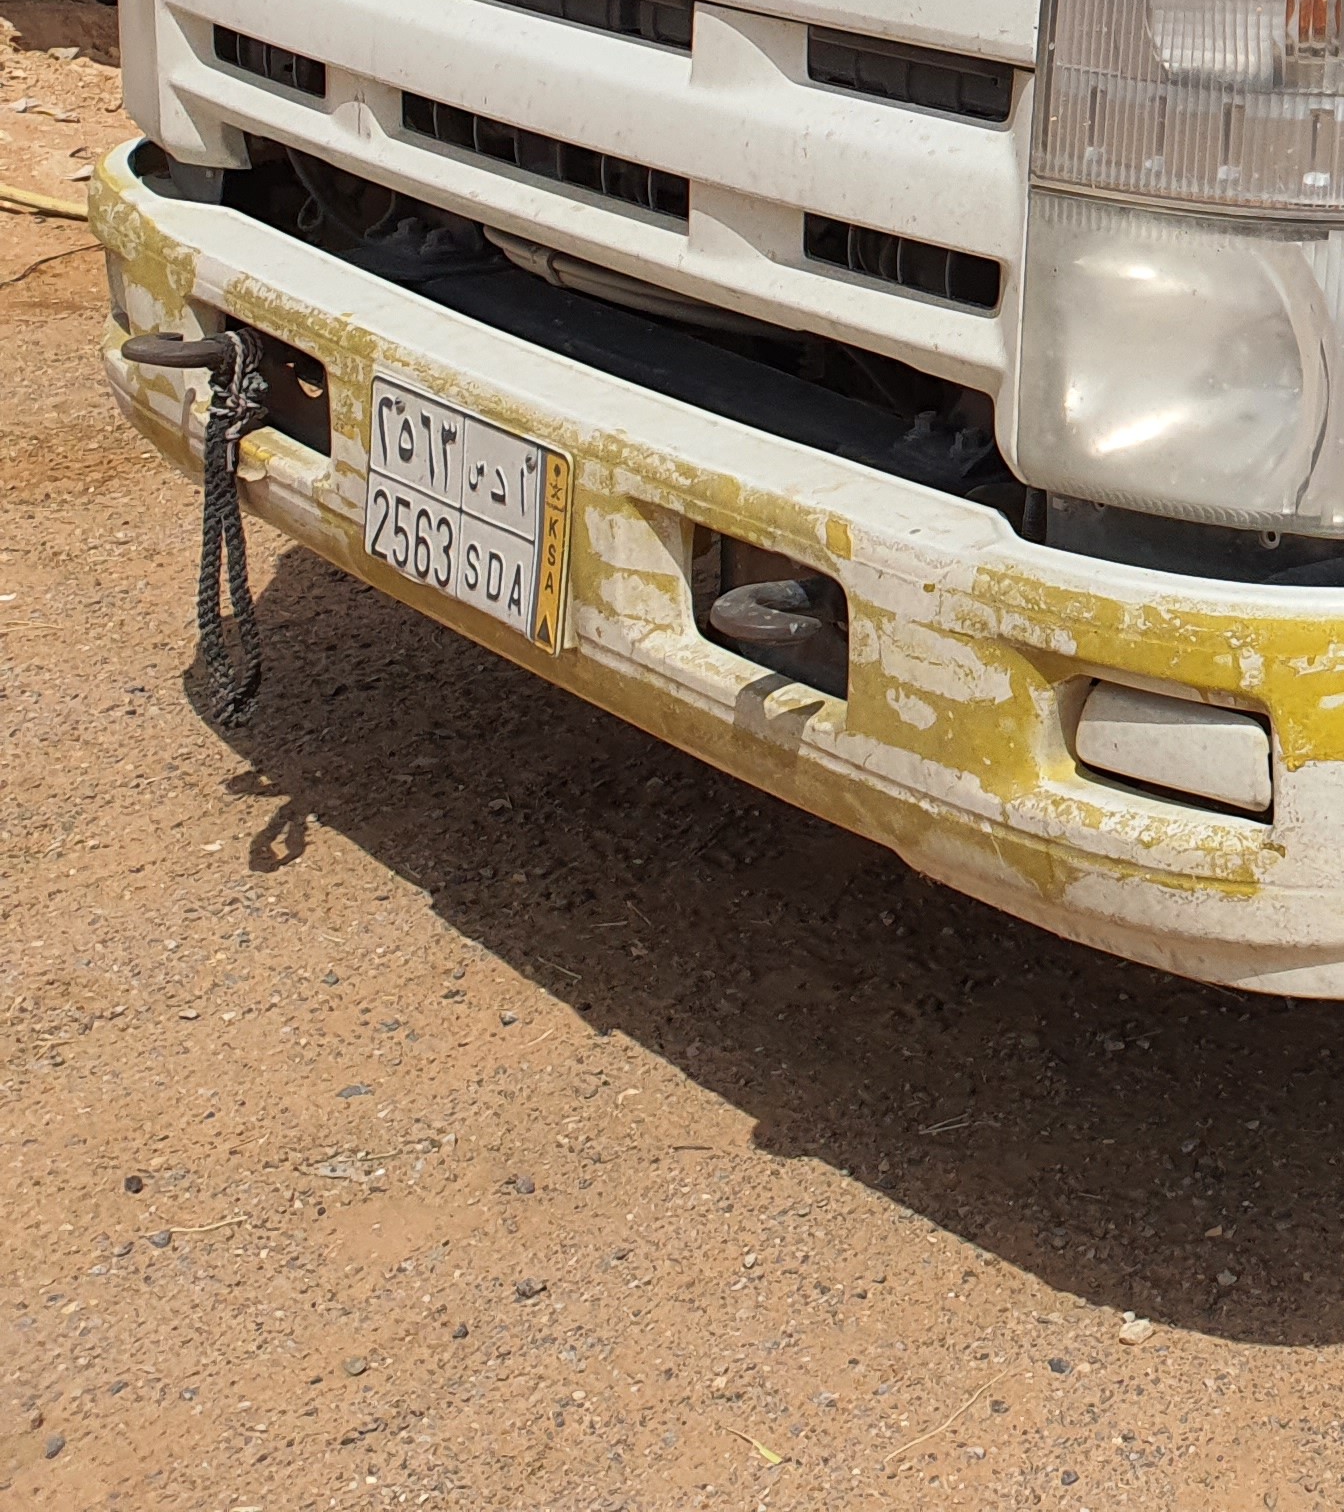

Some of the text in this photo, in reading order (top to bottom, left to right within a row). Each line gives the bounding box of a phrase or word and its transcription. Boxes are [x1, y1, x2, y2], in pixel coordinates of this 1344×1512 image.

[370, 488, 524, 617] 2563 SDA
[544, 516, 560, 595] KSA
